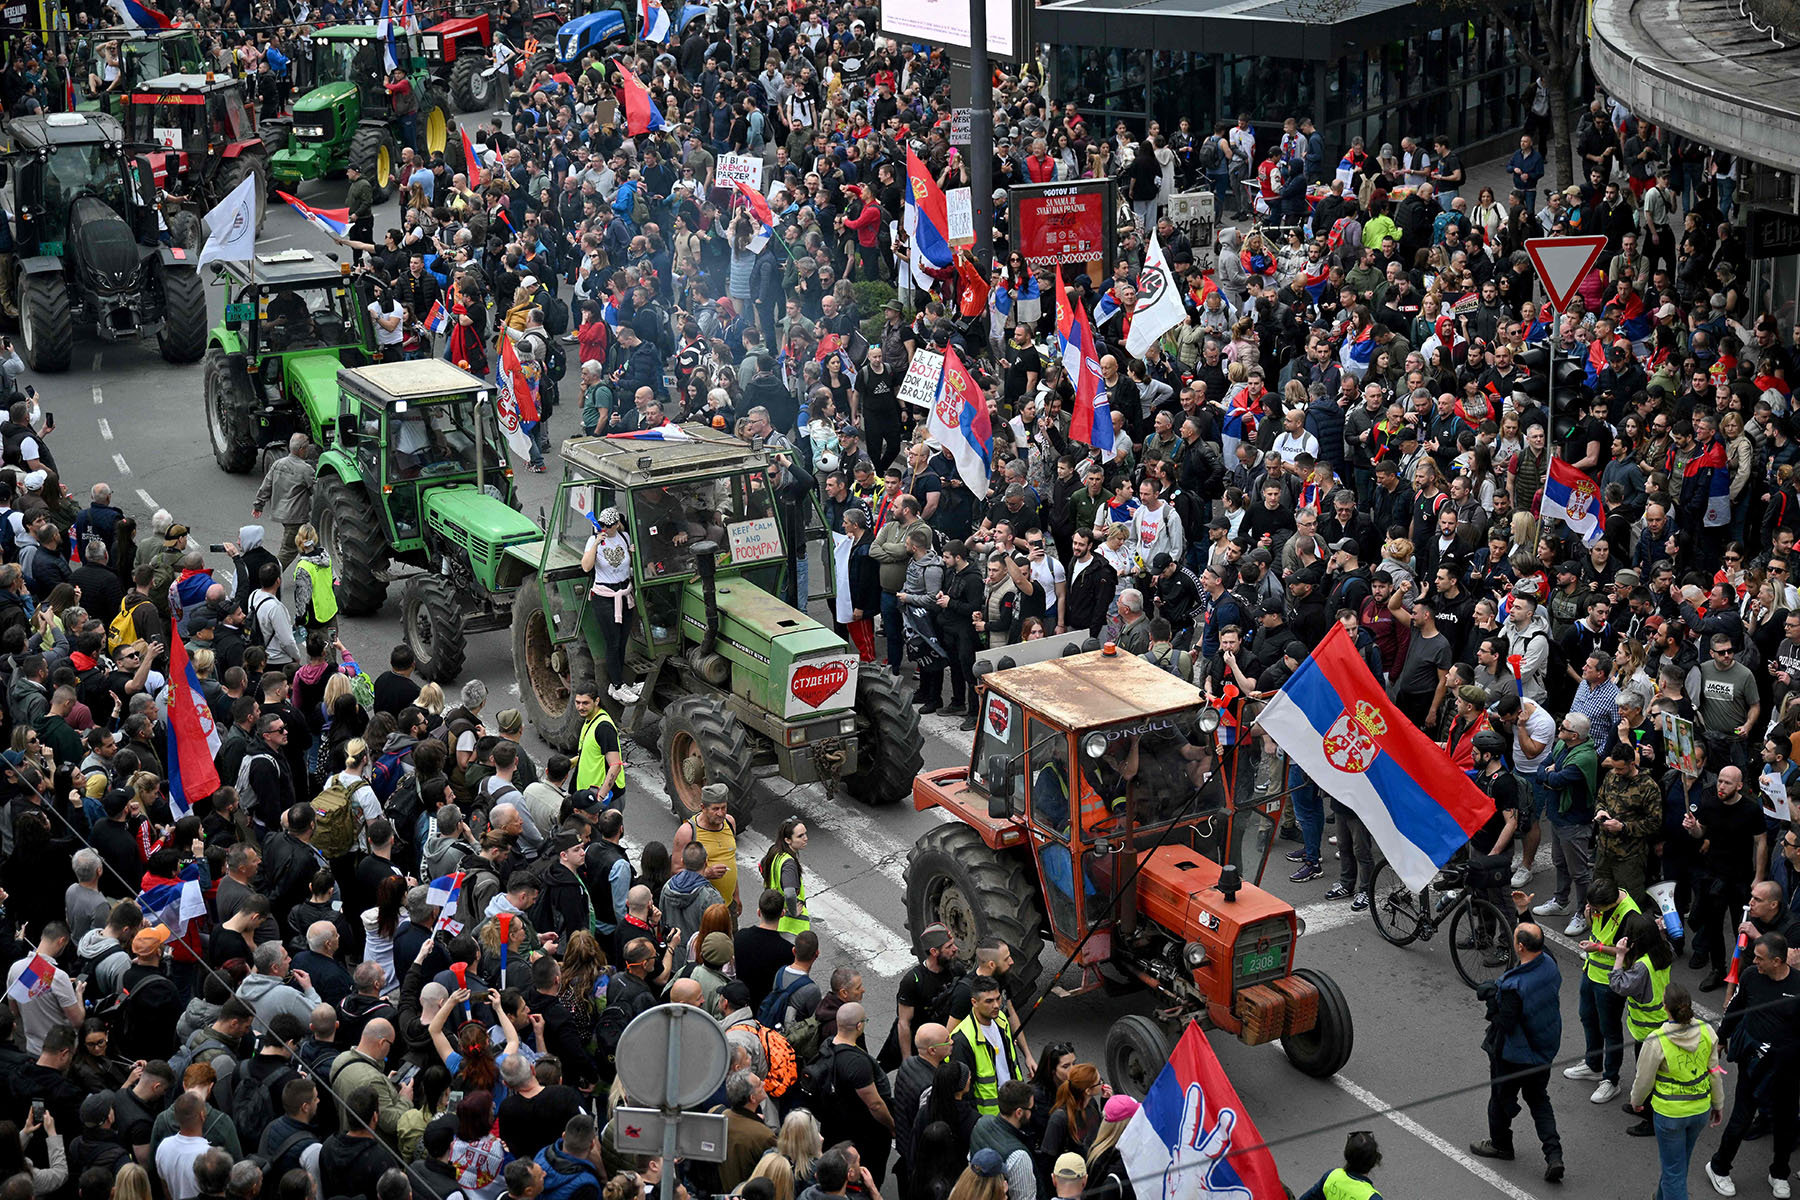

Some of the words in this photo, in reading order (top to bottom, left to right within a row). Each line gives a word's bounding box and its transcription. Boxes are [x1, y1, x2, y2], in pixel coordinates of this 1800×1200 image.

[719, 155, 728, 163] TI
[718, 163, 750, 172] SREMCU
[718, 171, 750, 180] PARIZER
[914, 350, 925, 364] JE
[905, 374, 921, 387] DOK
[732, 525, 750, 536] KEEP
[754, 522, 772, 531] CALM
[746, 535, 760, 543] AND
[735, 540, 778, 560] POOMPAY
[793, 672, 844, 690] СТУДЕНТИ
[1707, 683, 1725, 691] JACK
[1106, 719, 1173, 741] O'NEILL
[1249, 955, 1274, 971] 2308
